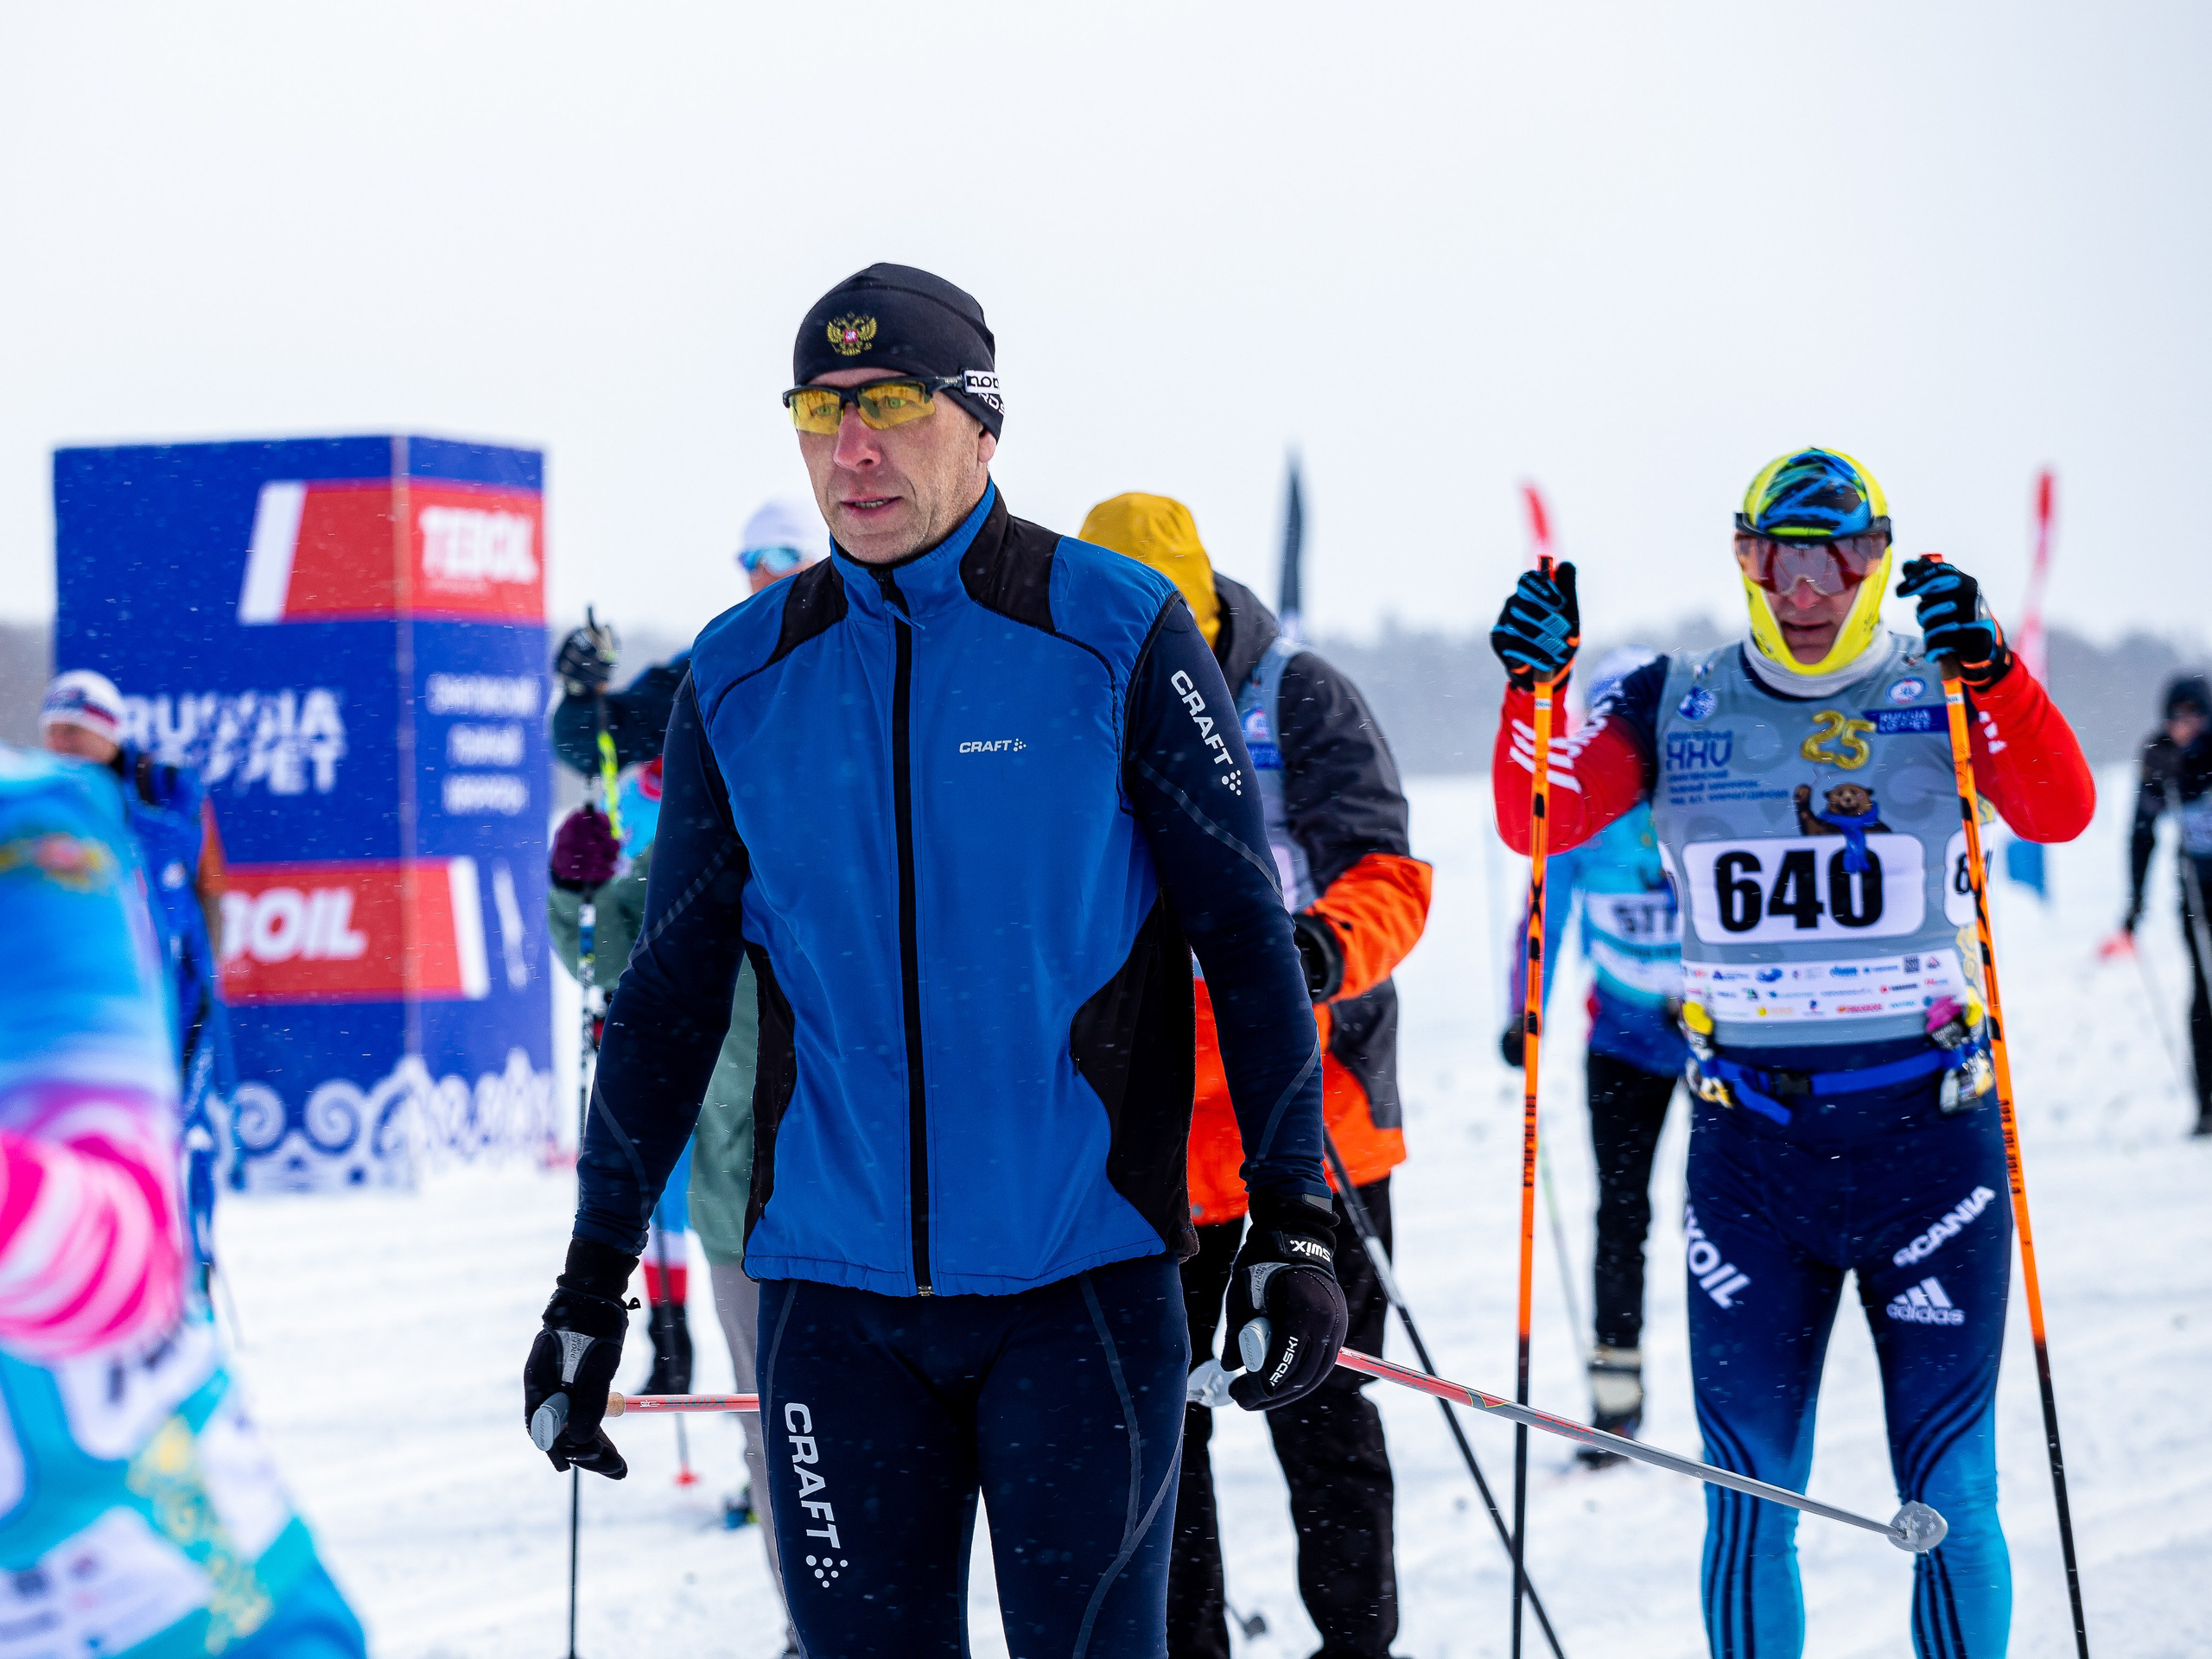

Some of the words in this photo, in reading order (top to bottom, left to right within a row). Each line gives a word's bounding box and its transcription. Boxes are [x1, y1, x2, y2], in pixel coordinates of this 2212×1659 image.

[959, 740, 1013, 753] CRAFT
[1170, 670, 1234, 765] CRAFT
[1800, 710, 1877, 771] 25
[1715, 850, 1883, 933] 640
[1892, 1185, 1996, 1268] SCANIA
[1885, 1303, 1966, 1326] adidas
[1269, 1336, 1299, 1387] RDSKI
[785, 1402, 841, 1549] CRAFT
